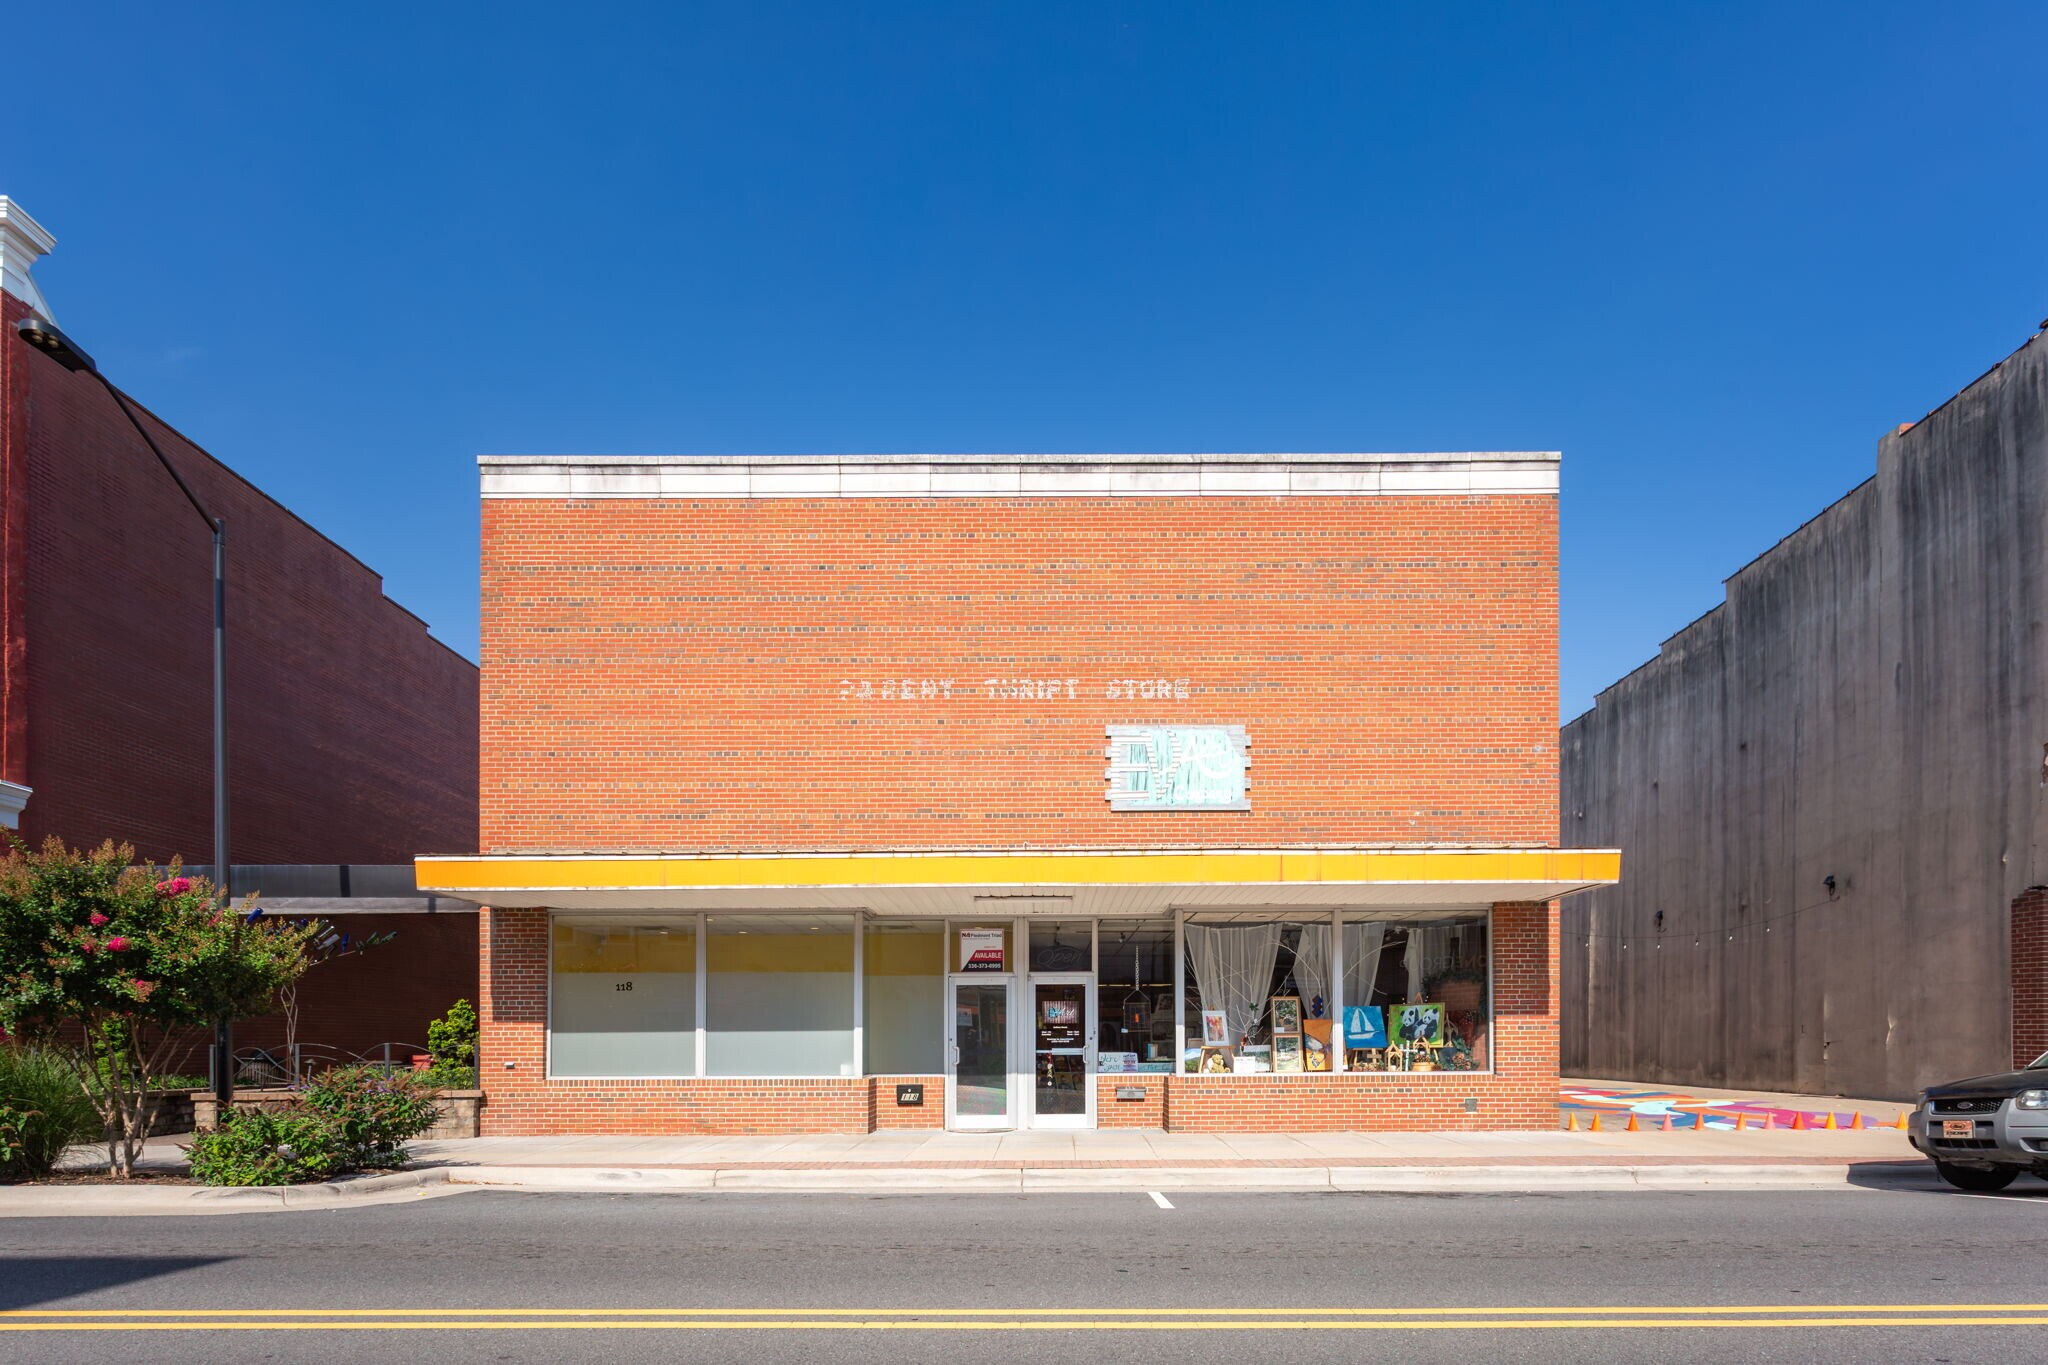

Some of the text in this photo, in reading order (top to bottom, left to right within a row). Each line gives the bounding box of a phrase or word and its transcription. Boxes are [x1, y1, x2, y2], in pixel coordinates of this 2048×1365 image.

[1106, 678, 1190, 699] STORE
[616, 981, 633, 992] 118
[901, 1093, 919, 1101] 118
